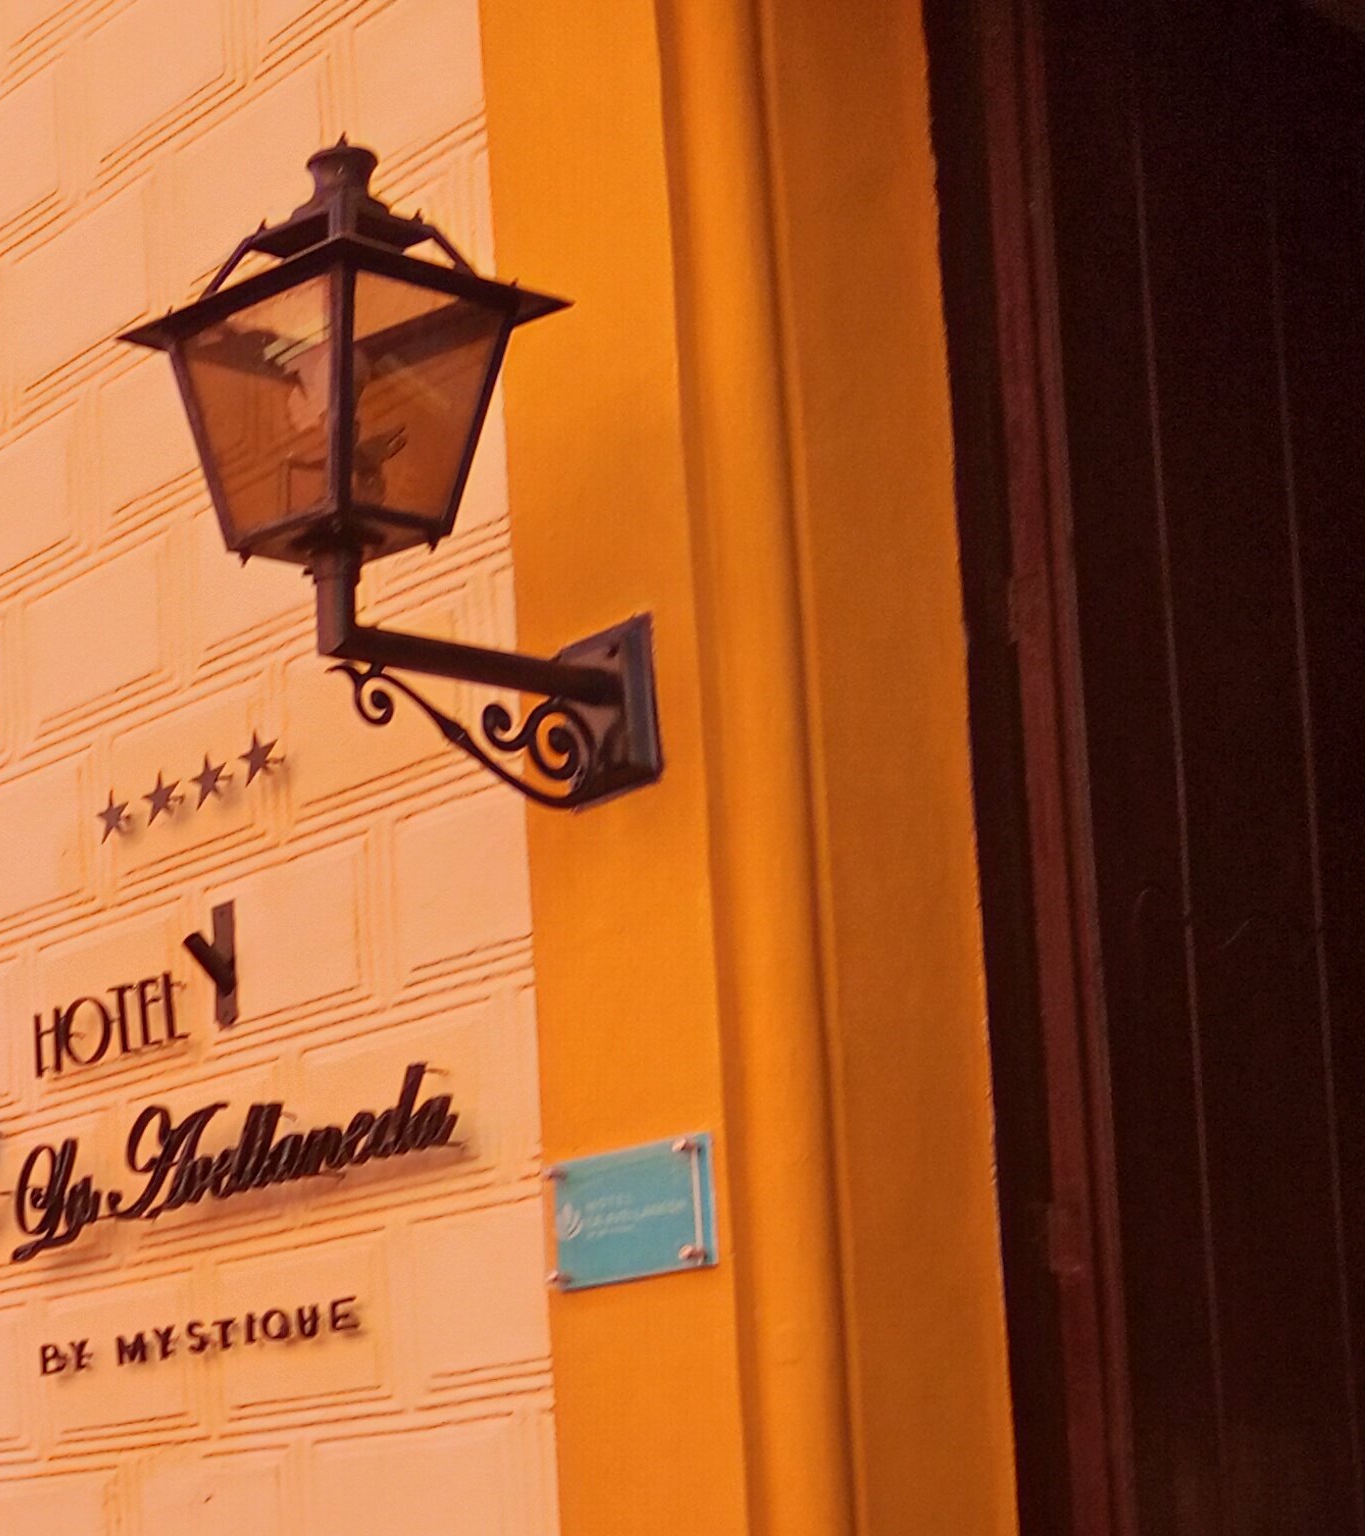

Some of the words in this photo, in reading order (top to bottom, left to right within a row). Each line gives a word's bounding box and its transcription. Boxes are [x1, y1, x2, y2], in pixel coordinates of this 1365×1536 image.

[33, 970, 190, 1079] HOTEL
[107, 1062, 461, 1220] Avellaneda
[40, 1338, 91, 1377] BY
[115, 1295, 361, 1367] MYSTIQUE
